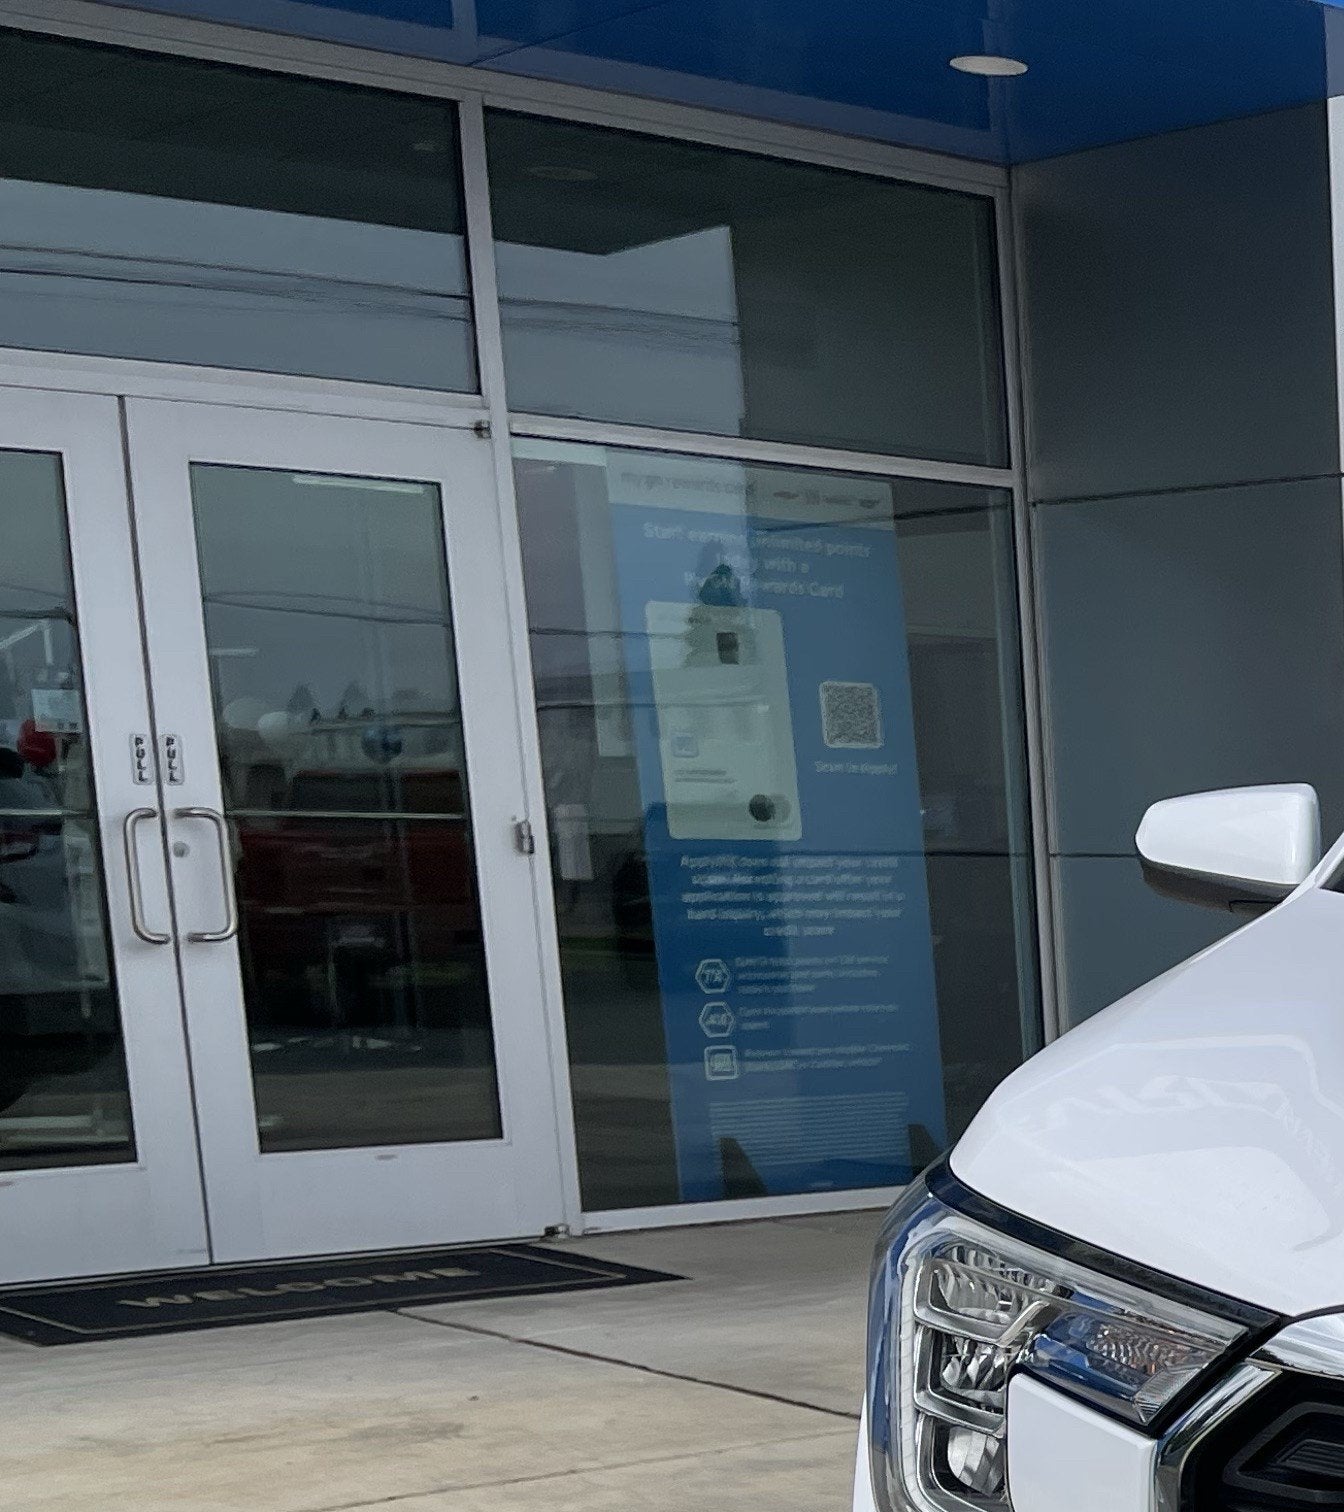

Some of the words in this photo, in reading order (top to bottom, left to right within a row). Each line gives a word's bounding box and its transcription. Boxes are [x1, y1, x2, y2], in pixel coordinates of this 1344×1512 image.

[134, 736, 147, 782] PULL
[166, 736, 178, 782] PULL
[117, 1267, 481, 1307] WELCOME
